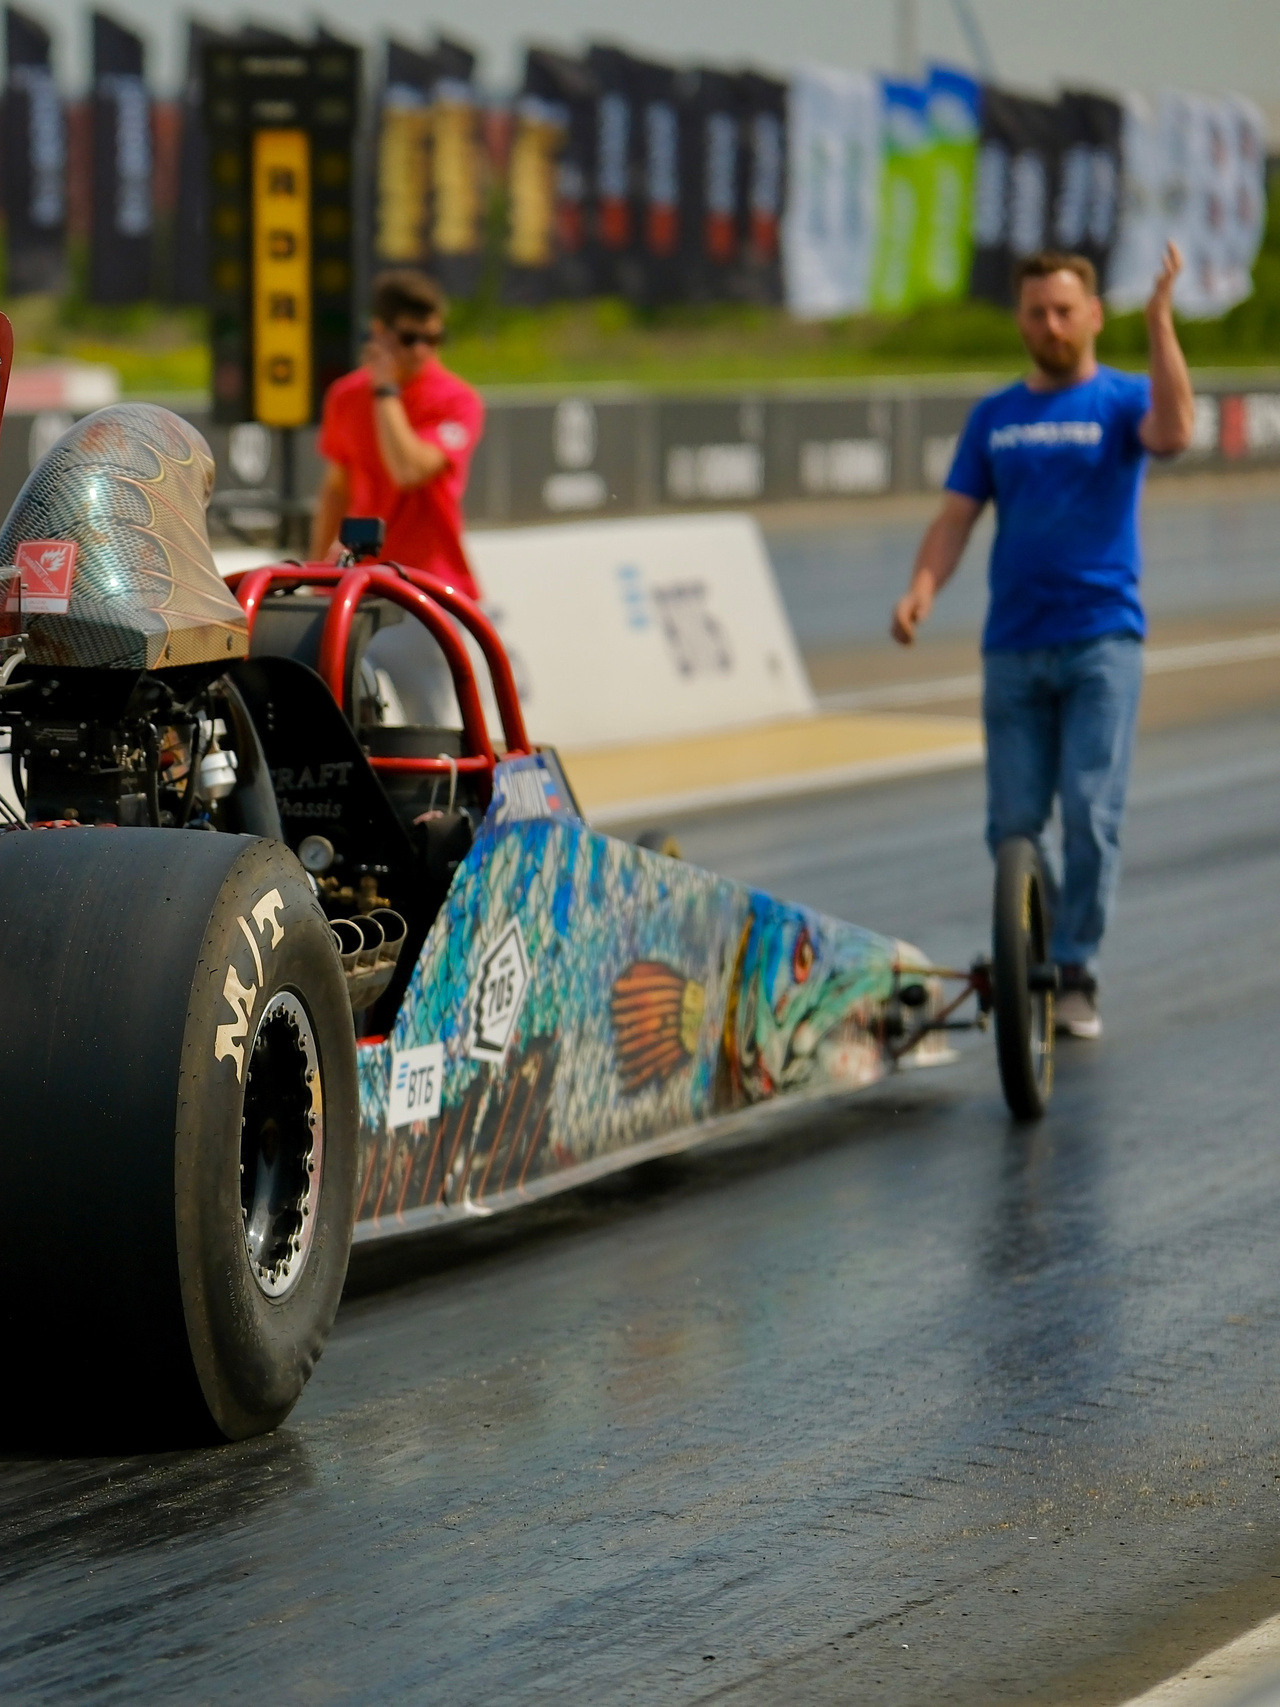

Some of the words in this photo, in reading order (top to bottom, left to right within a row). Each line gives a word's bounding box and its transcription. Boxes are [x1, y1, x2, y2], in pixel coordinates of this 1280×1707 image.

[270, 761, 354, 792] RAFT
[276, 797, 343, 819] hassis
[214, 888, 285, 1085] M/T
[407, 1065, 434, 1108] ВТБ
